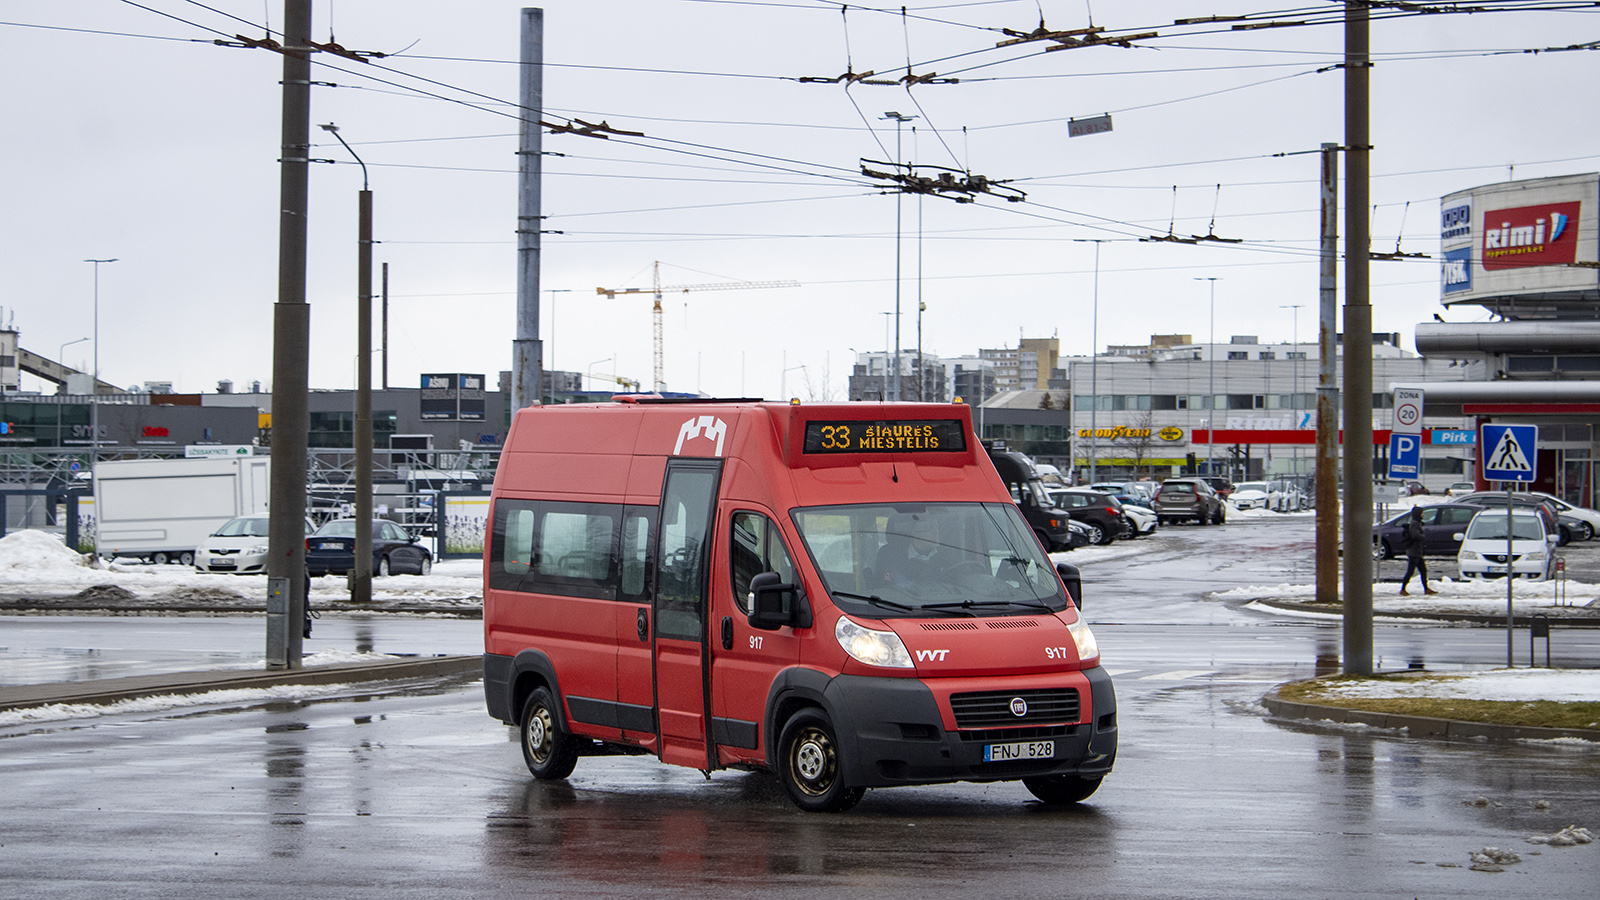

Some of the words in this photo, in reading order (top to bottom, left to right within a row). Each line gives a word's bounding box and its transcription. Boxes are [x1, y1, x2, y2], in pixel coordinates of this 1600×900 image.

[1486, 219, 1546, 249] Rimi
[1402, 410, 1414, 419] 20
[821, 425, 851, 449] 33
[865, 425, 933, 437] ŠIAURĖS
[1441, 432, 1468, 442] Pirk
[859, 437, 939, 449] MIESTELIS
[1397, 437, 1414, 460] P
[749, 635, 763, 650] 917
[1045, 647, 1067, 659] 917
[992, 744, 1020, 759] FNJ
[1029, 742, 1052, 757] 528
